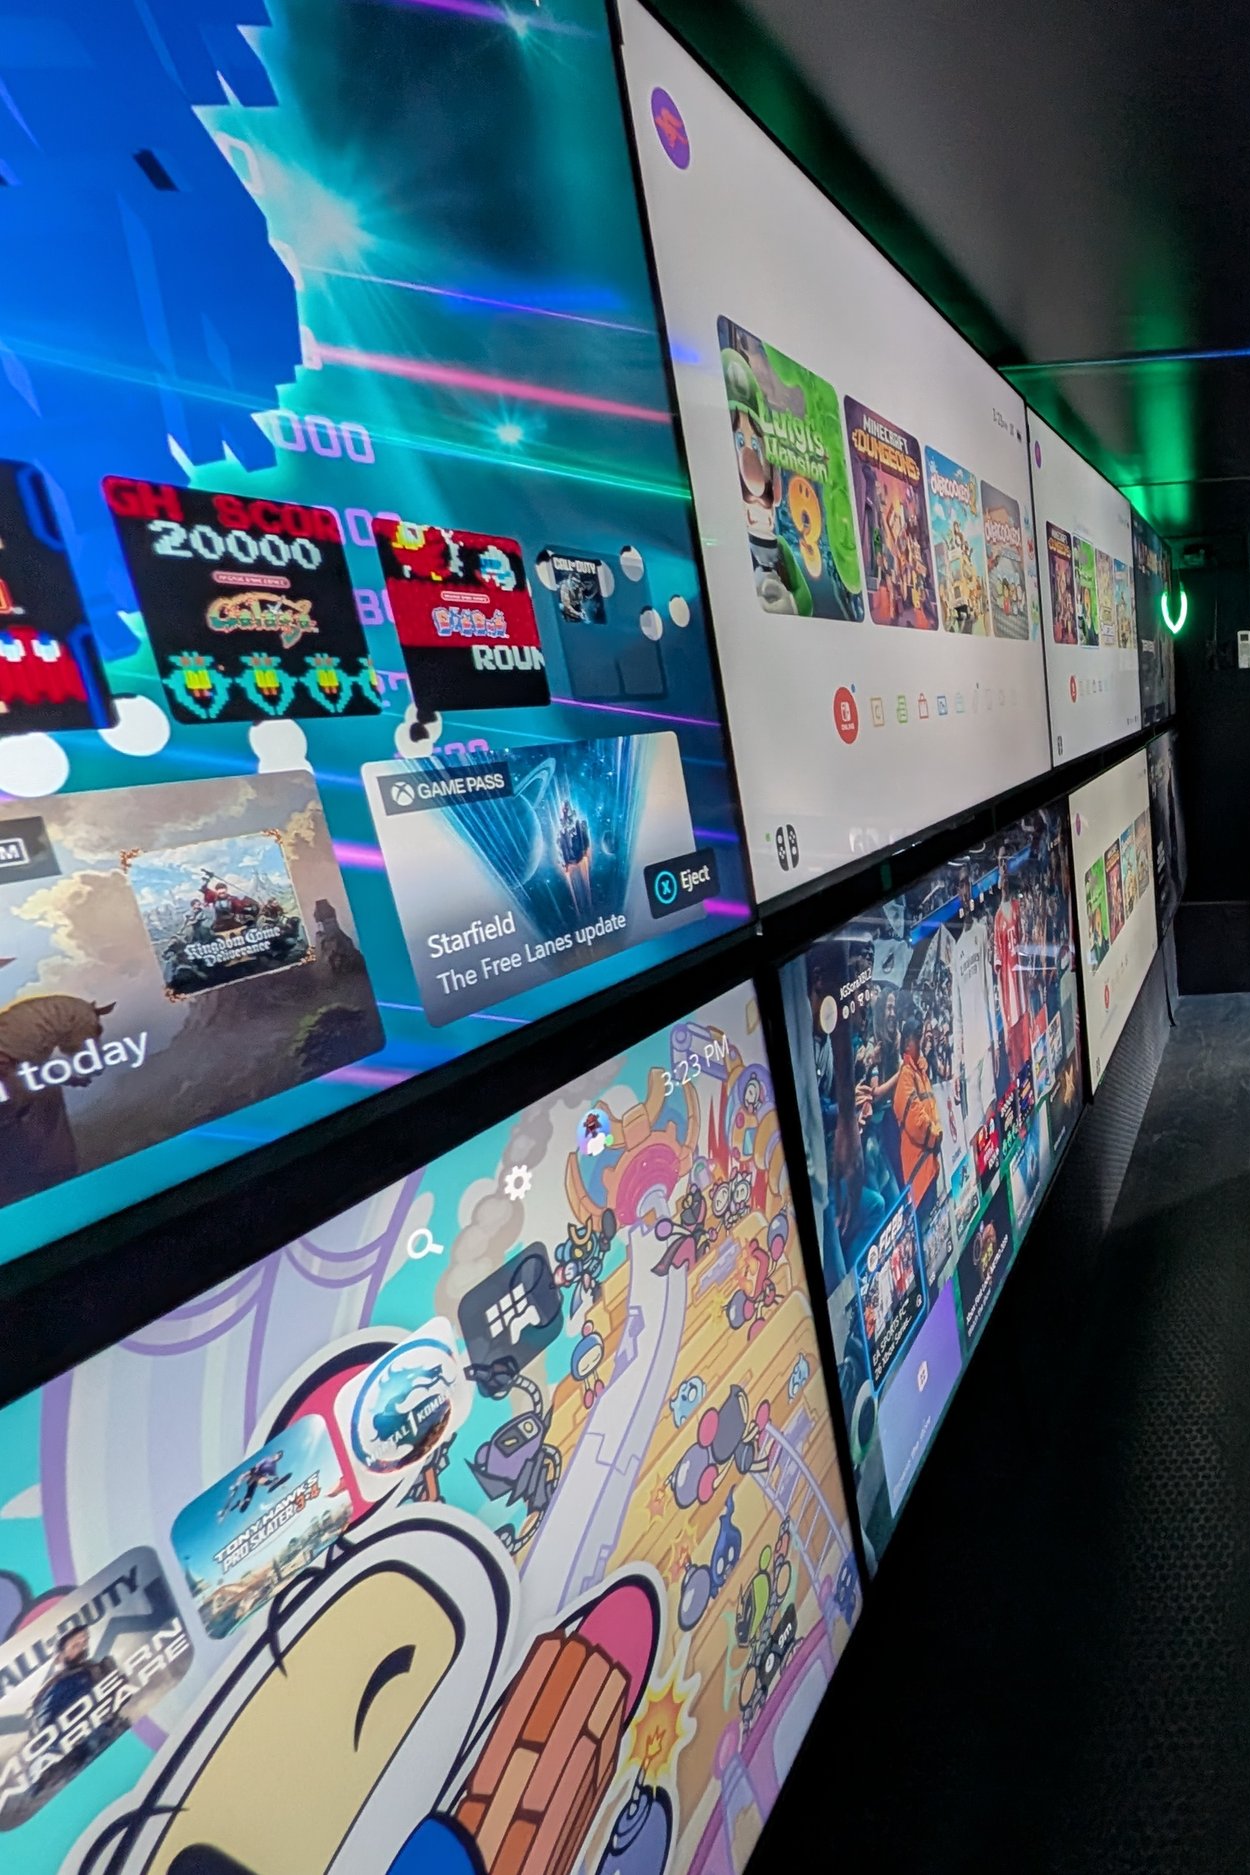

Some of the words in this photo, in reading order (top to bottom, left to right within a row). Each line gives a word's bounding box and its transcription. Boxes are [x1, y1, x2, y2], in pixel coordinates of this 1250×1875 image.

[148, 520, 322, 570] 20000
[417, 776, 466, 801] GAME
[466, 772, 506, 793] PASS
[680, 865, 711, 893] Eject
[184, 936, 246, 960] Kingdom
[245, 925, 281, 944] Come
[427, 911, 516, 959] Starfield
[437, 965, 478, 996] The
[481, 952, 523, 981] Free
[525, 931, 573, 964] Lanes
[575, 912, 628, 951] update
[18, 1031, 148, 1092] today
[661, 1054, 702, 1097] 3:23
[704, 1033, 730, 1068] PM
[212, 1518, 263, 1564] TONY
[221, 1540, 250, 1575] PRO
[248, 1503, 297, 1551] SKATER
